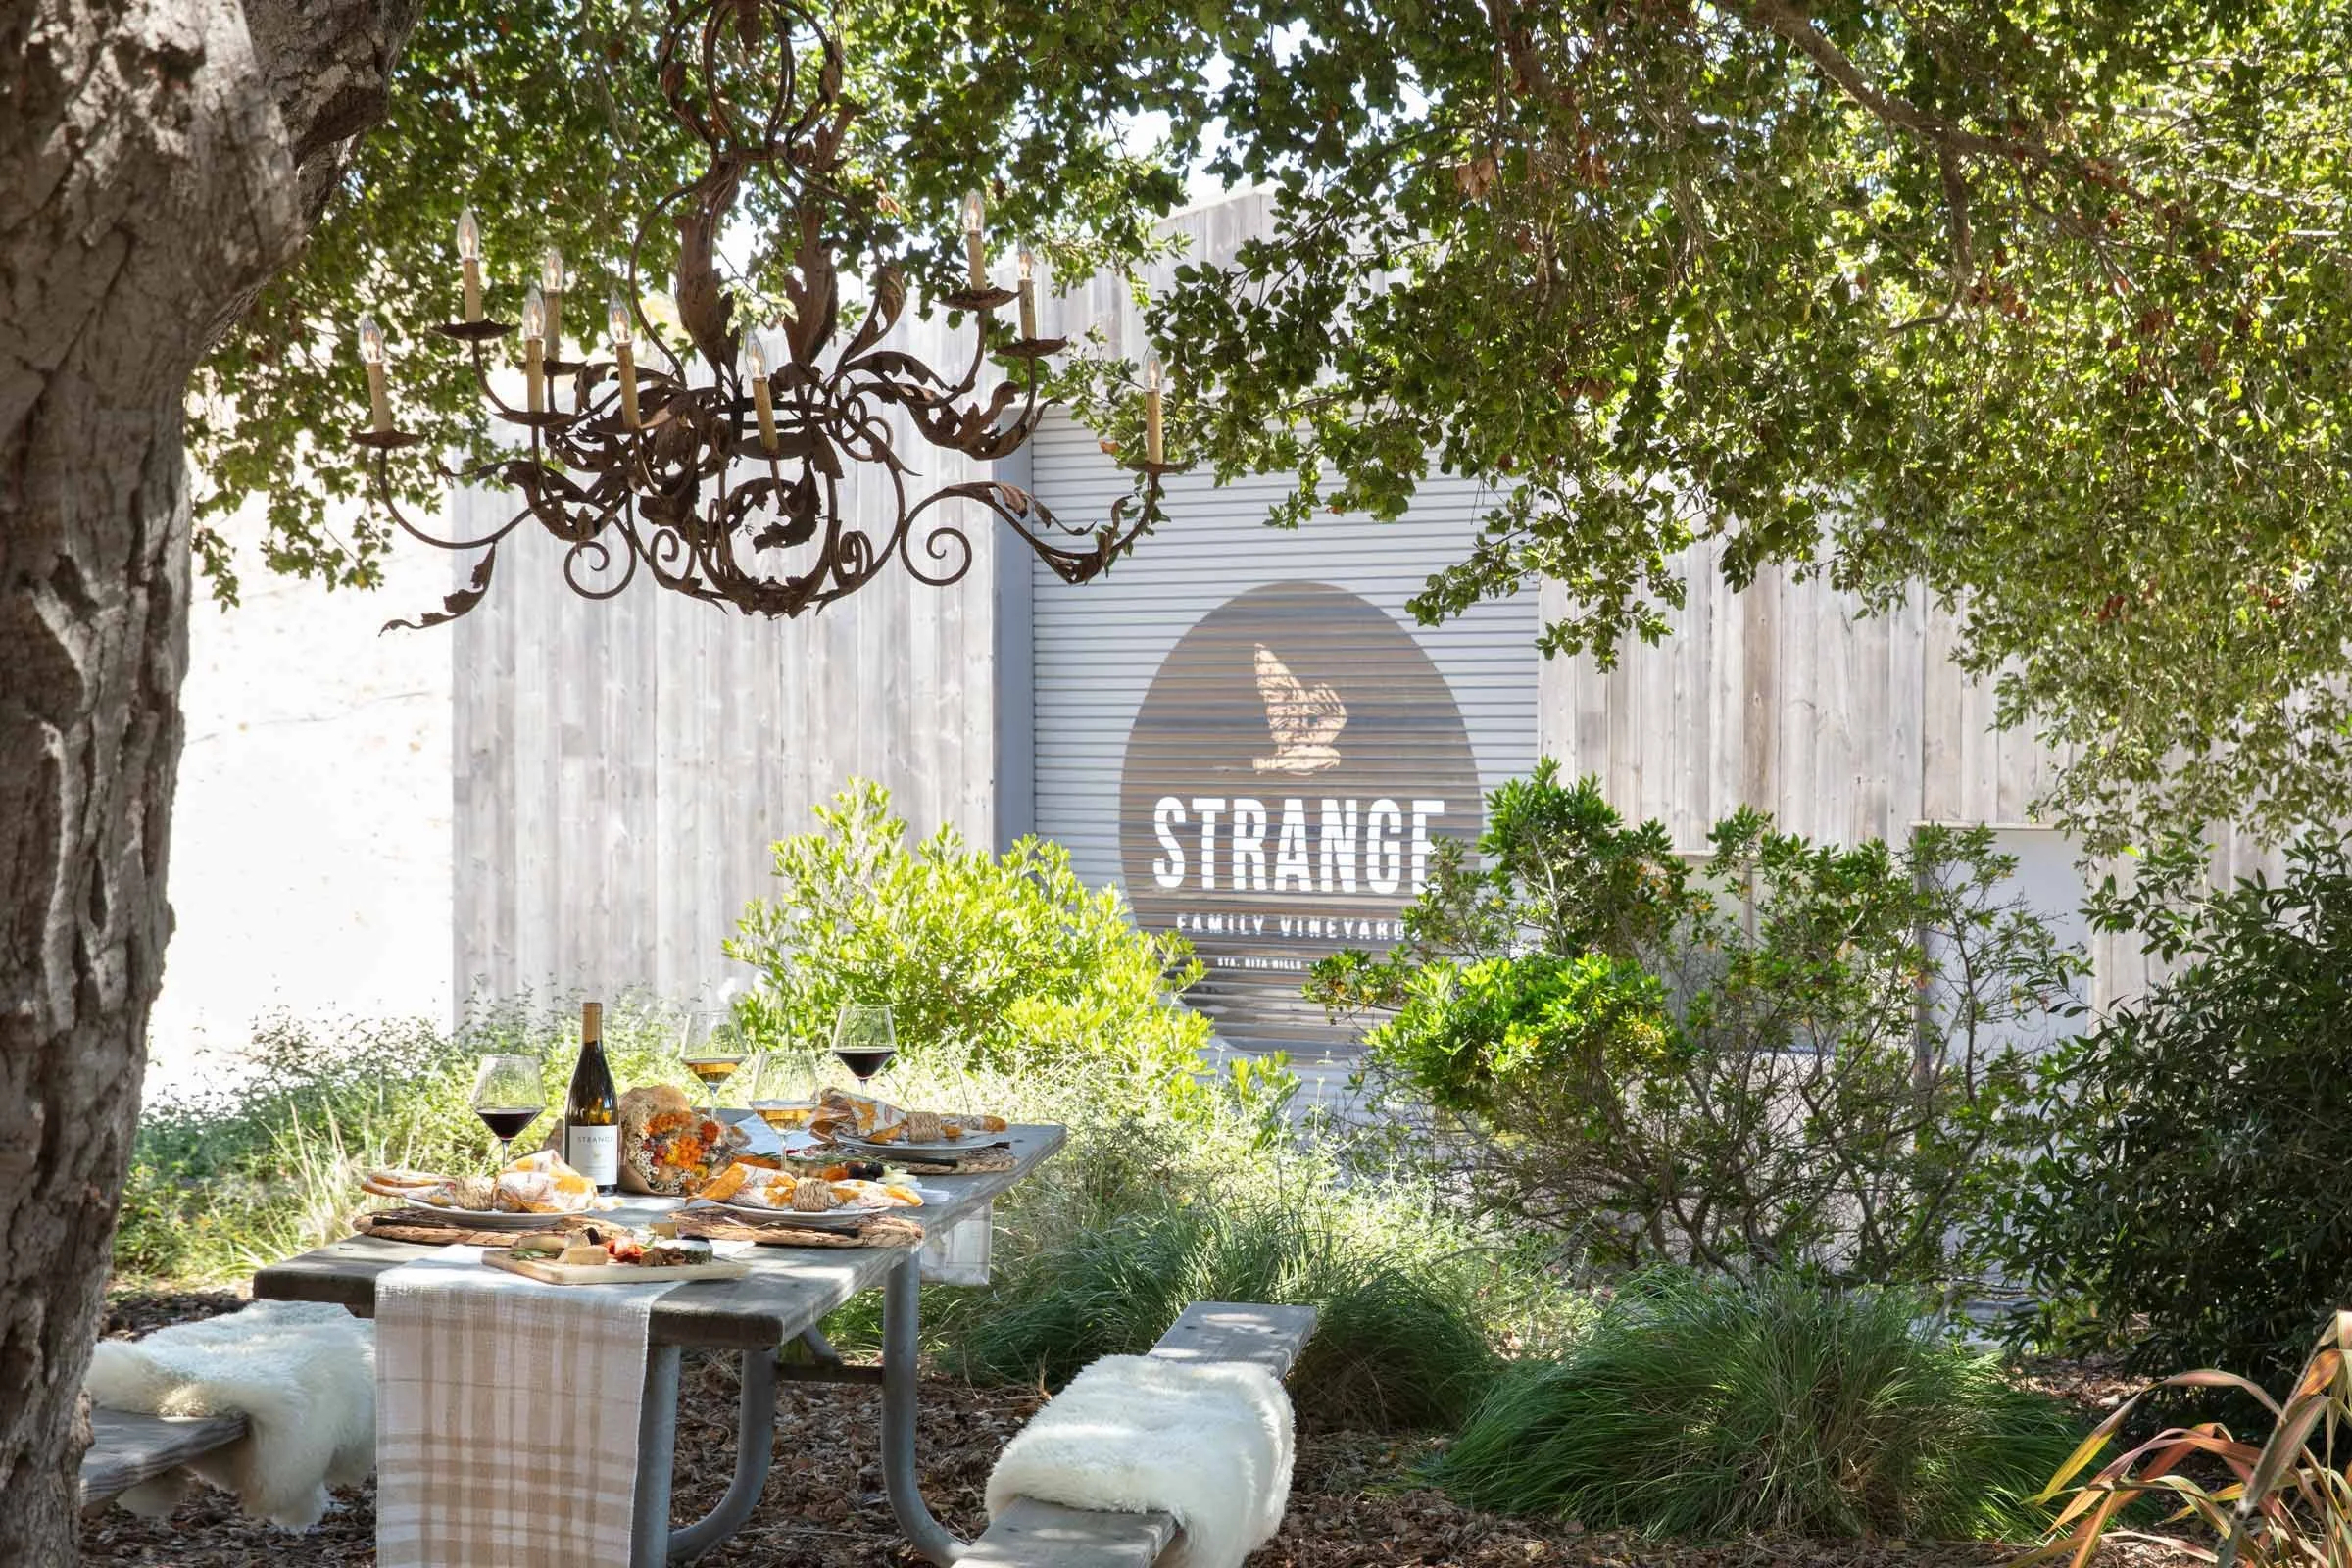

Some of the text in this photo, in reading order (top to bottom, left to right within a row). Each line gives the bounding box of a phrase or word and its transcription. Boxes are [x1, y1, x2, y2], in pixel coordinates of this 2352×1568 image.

[1152, 796, 1445, 894] STRANGE
[1176, 913, 1264, 936] FAMILY
[1245, 957, 1267, 968] RITA
[1272, 959, 1301, 970] HILLS
